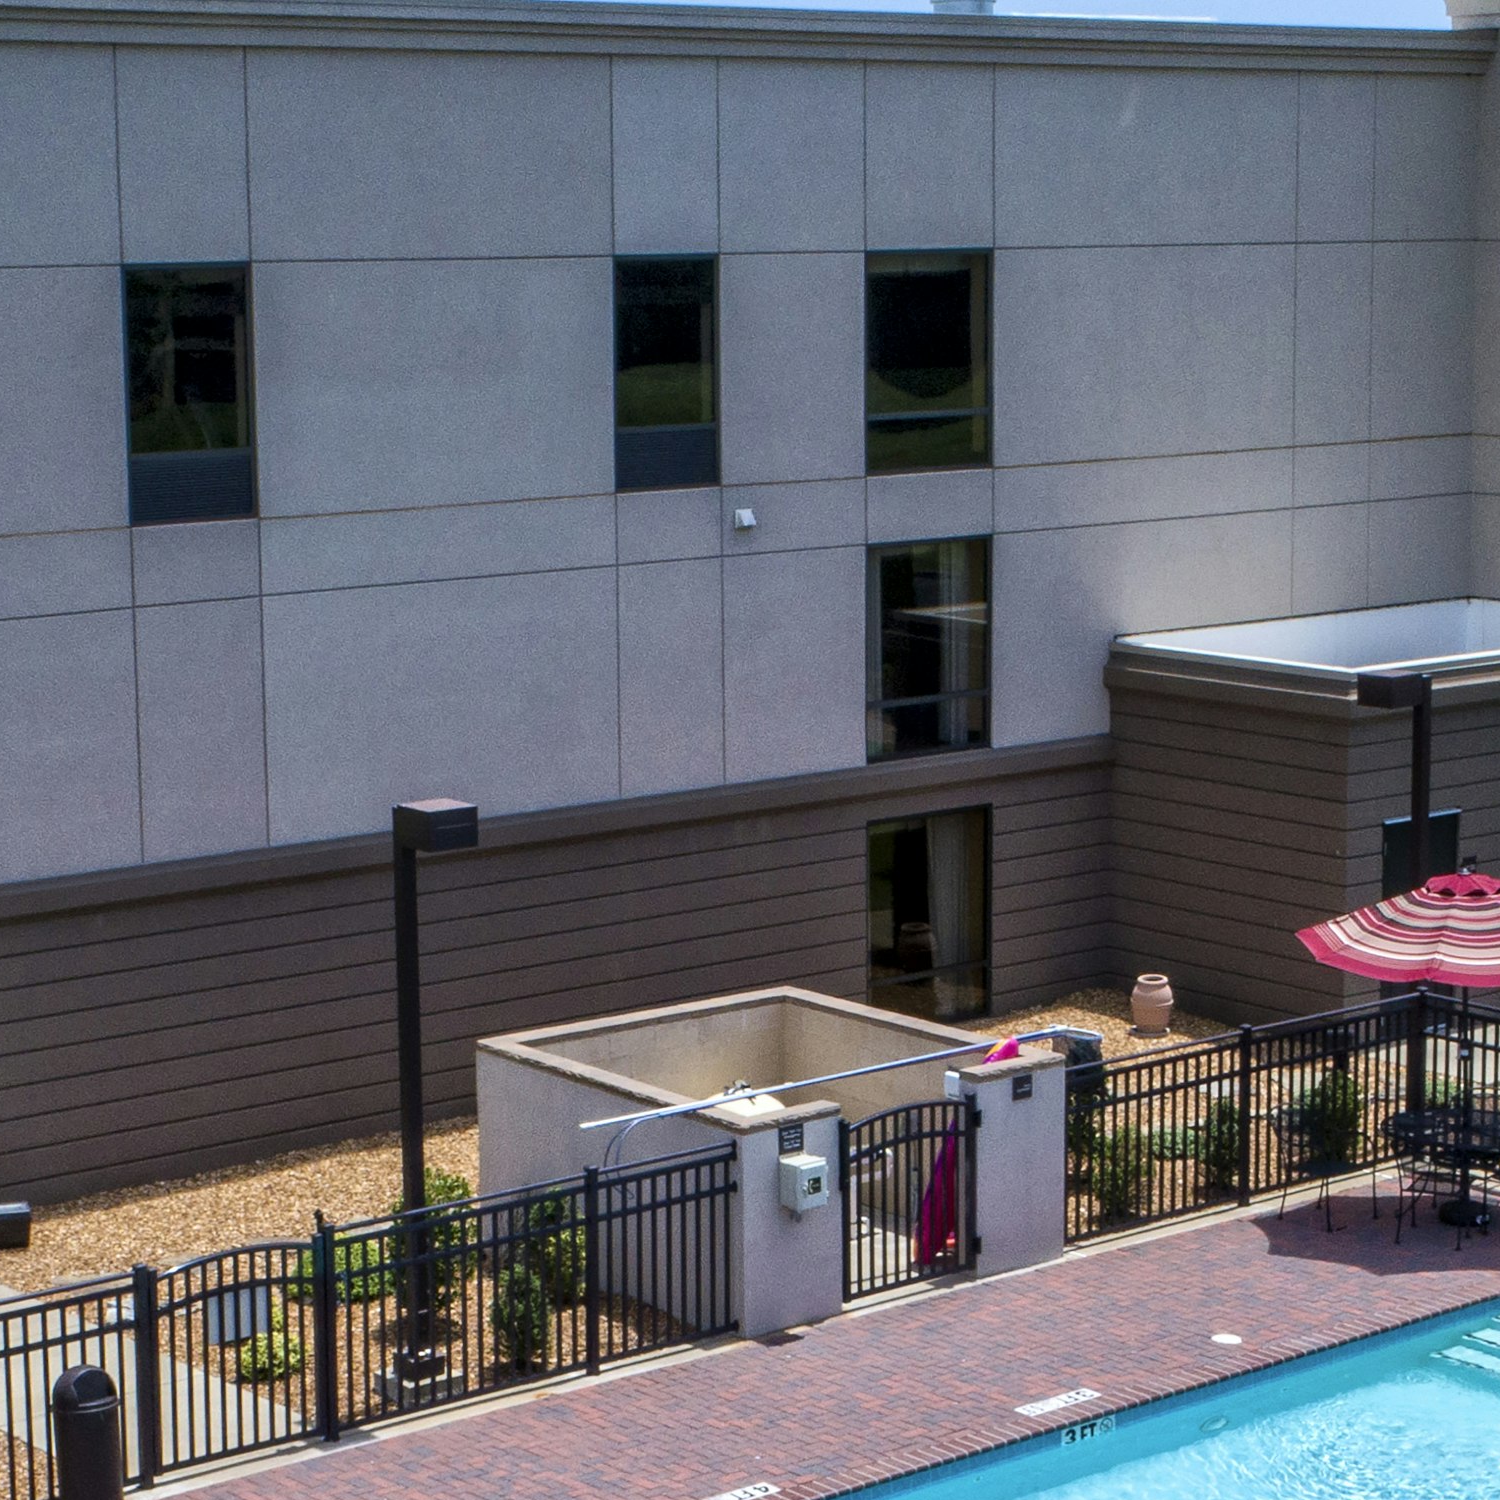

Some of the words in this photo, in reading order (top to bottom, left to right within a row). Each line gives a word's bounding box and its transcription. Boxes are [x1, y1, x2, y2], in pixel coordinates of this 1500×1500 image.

[1064, 1428, 1077, 1445] 3
[1080, 1422, 1098, 1440] FT
[730, 1489, 755, 1500] FT
[752, 1485, 770, 1493] 4
